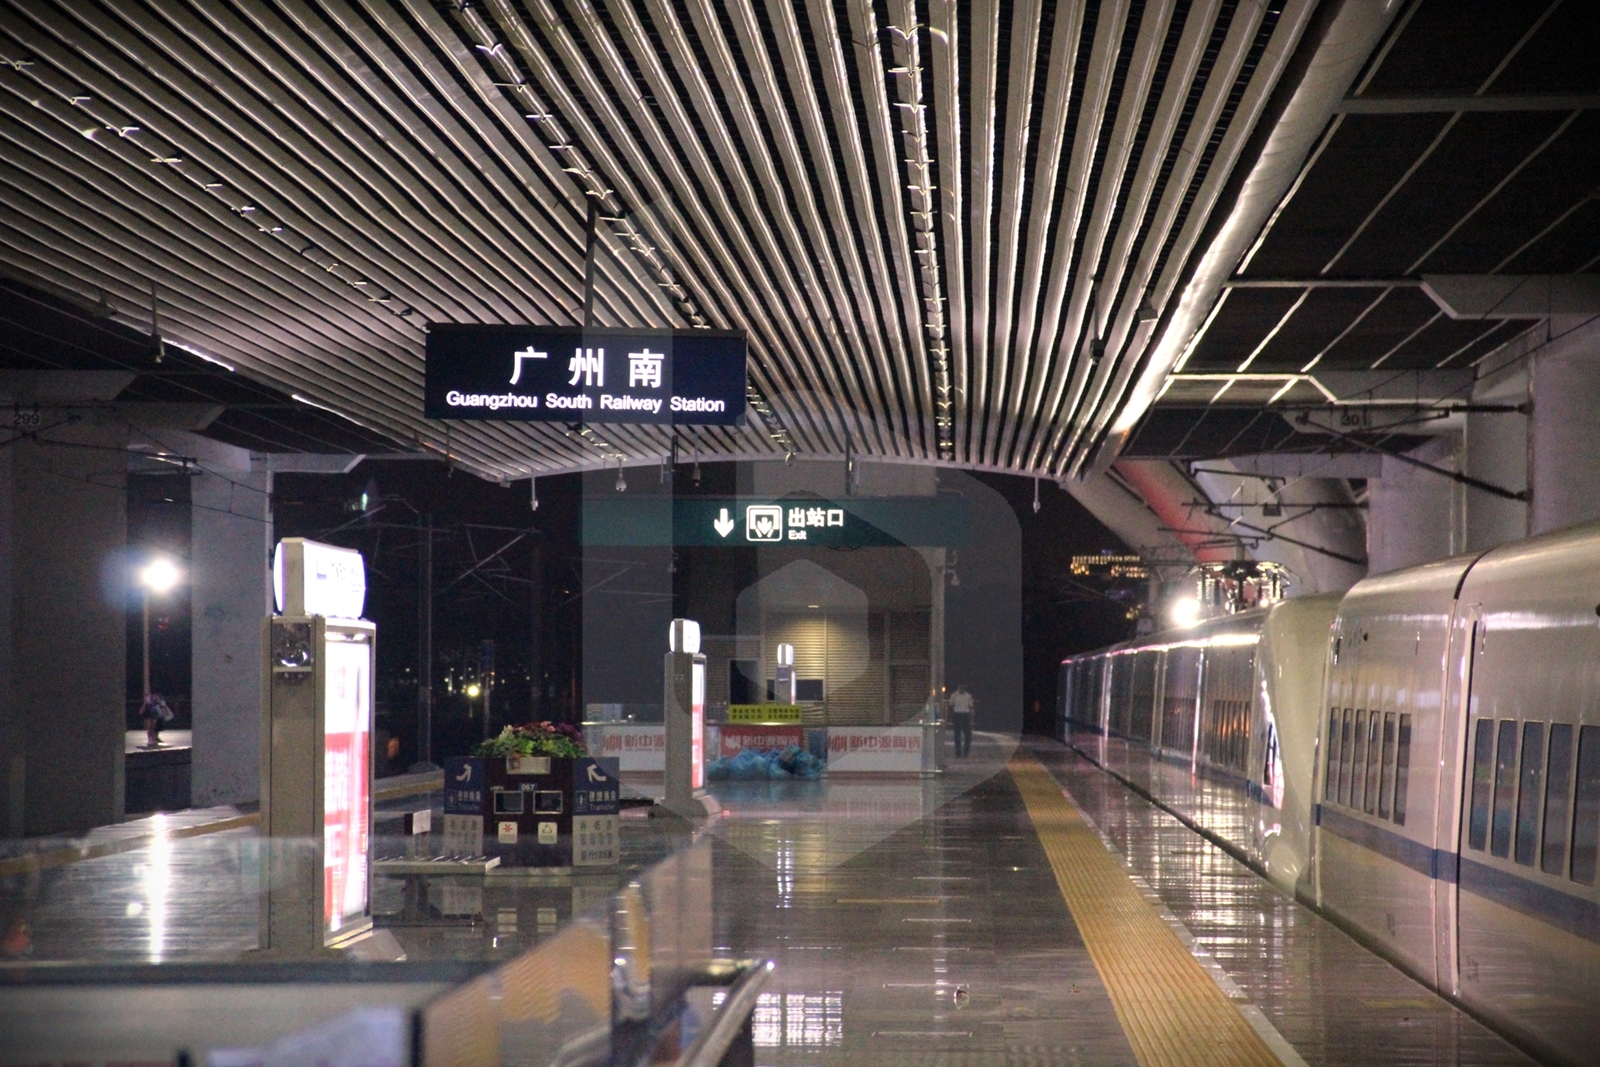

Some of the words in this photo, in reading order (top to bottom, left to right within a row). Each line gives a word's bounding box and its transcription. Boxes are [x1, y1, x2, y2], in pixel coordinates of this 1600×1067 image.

[509, 346, 665, 388] 广州南
[446, 390, 538, 410] Guangzhou
[545, 393, 592, 409] South
[600, 395, 662, 414] Railway
[670, 396, 725, 412] Station
[13, 413, 40, 425] 299
[788, 507, 843, 527] 出站口
[788, 530, 807, 540] Exit
[521, 783, 535, 791] 067
[589, 803, 616, 811] Transfer
